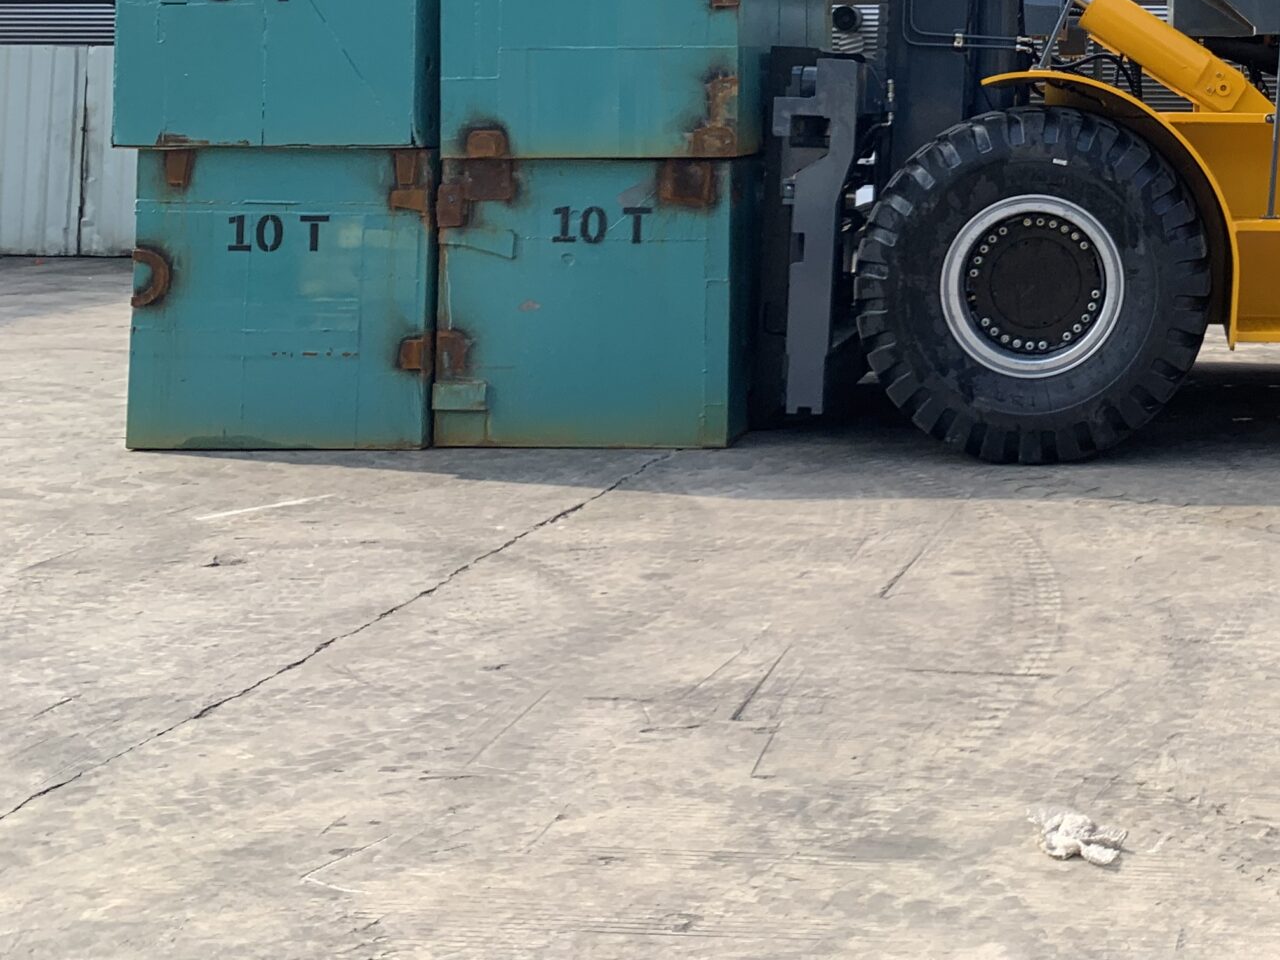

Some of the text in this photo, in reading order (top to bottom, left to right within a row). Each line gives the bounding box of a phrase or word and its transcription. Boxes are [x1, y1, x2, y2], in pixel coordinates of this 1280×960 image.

[226, 214, 332, 253] 10 T
[550, 205, 654, 246] 10 T
